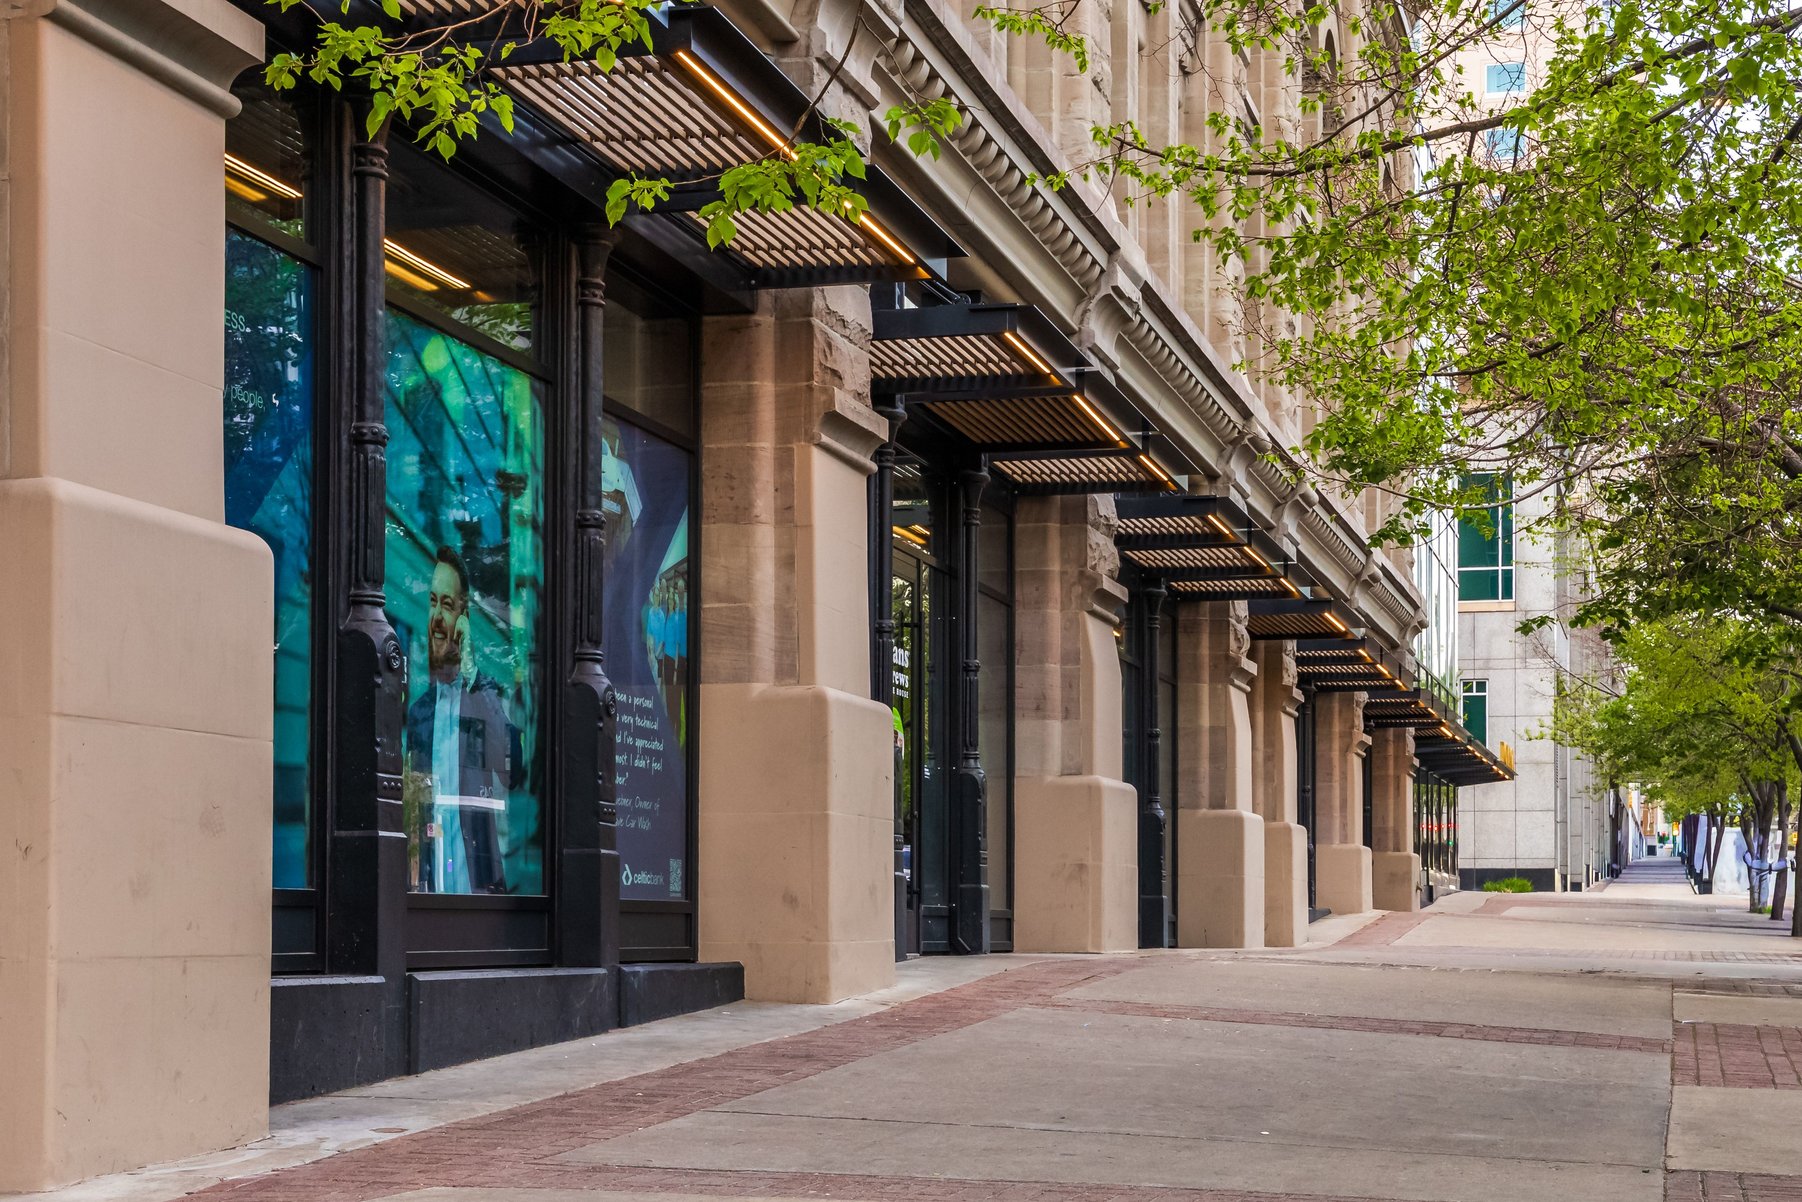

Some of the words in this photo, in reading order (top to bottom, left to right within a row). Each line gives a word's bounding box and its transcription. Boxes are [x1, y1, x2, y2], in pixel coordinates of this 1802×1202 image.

[634, 695, 654, 712] personal
[621, 714, 634, 733] very
[636, 713, 659, 731] technical
[636, 735, 664, 755] appreciated
[652, 756, 663, 776] feel
[635, 795, 652, 810] Owner
